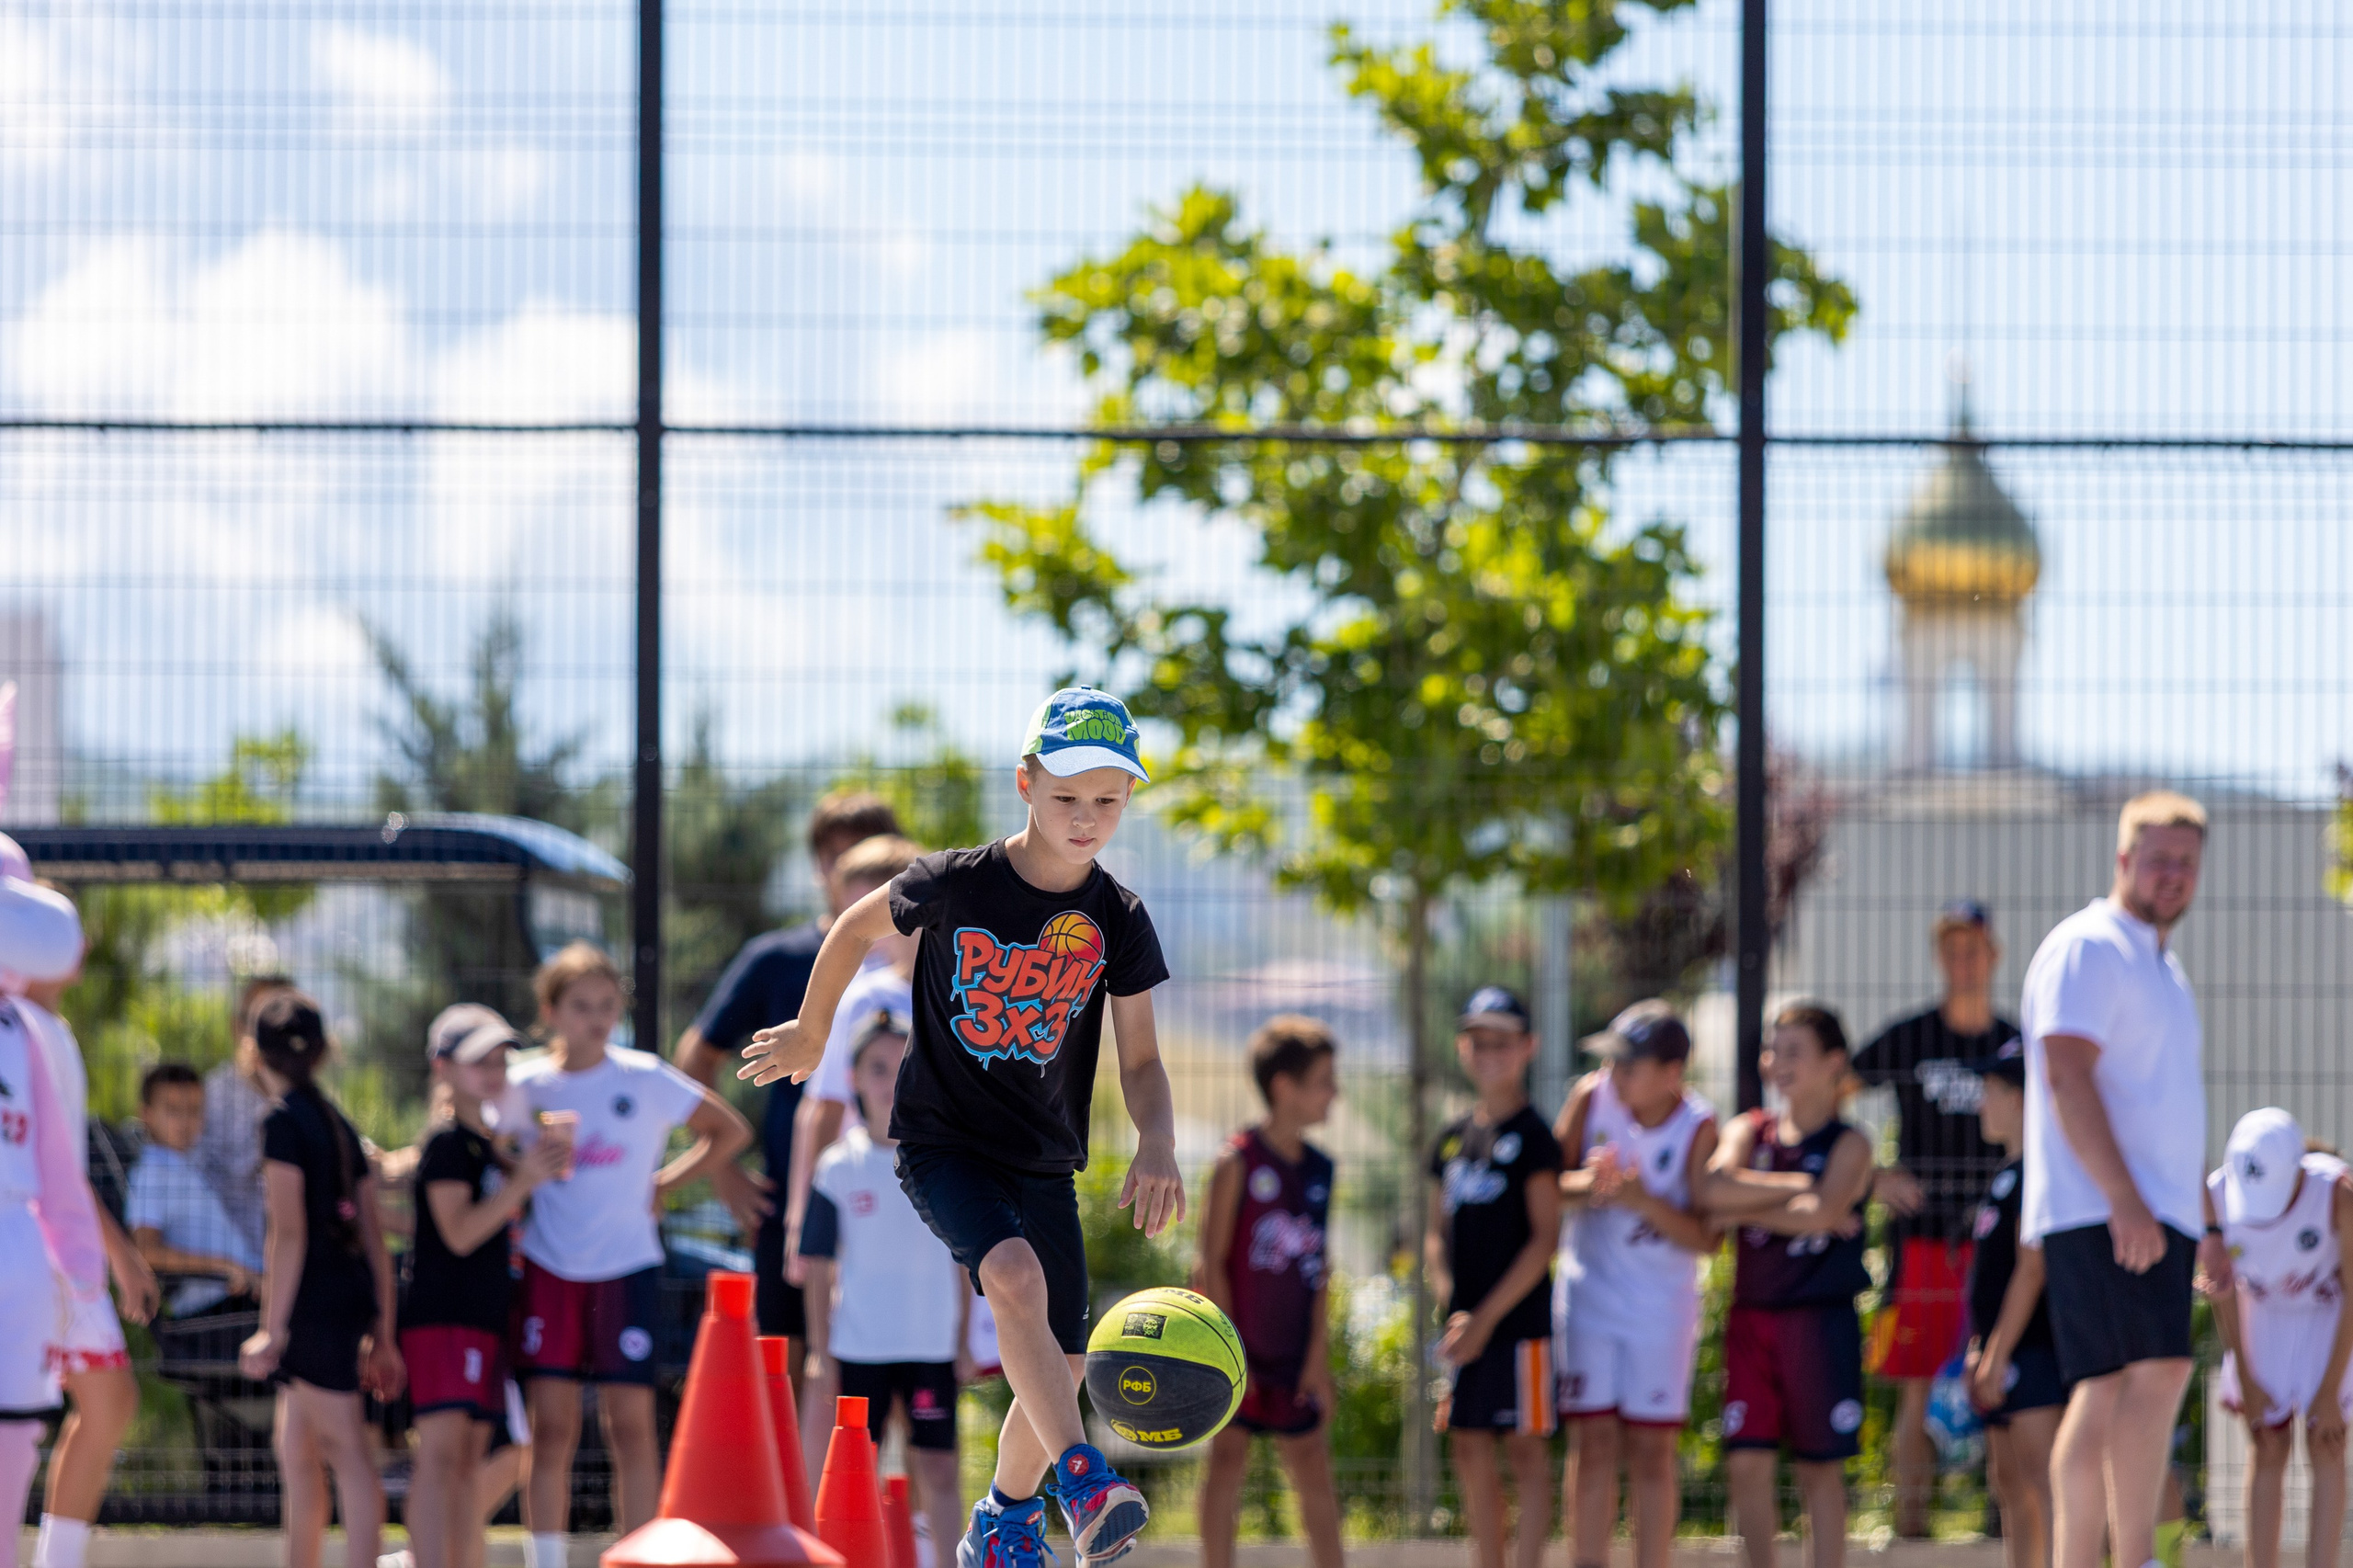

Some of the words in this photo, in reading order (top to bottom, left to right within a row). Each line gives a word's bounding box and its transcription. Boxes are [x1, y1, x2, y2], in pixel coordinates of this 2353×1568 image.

[1066, 718, 1126, 745] MOOD
[959, 931, 1106, 1004] РУБИН
[1122, 1380, 1152, 1392] РФБ
